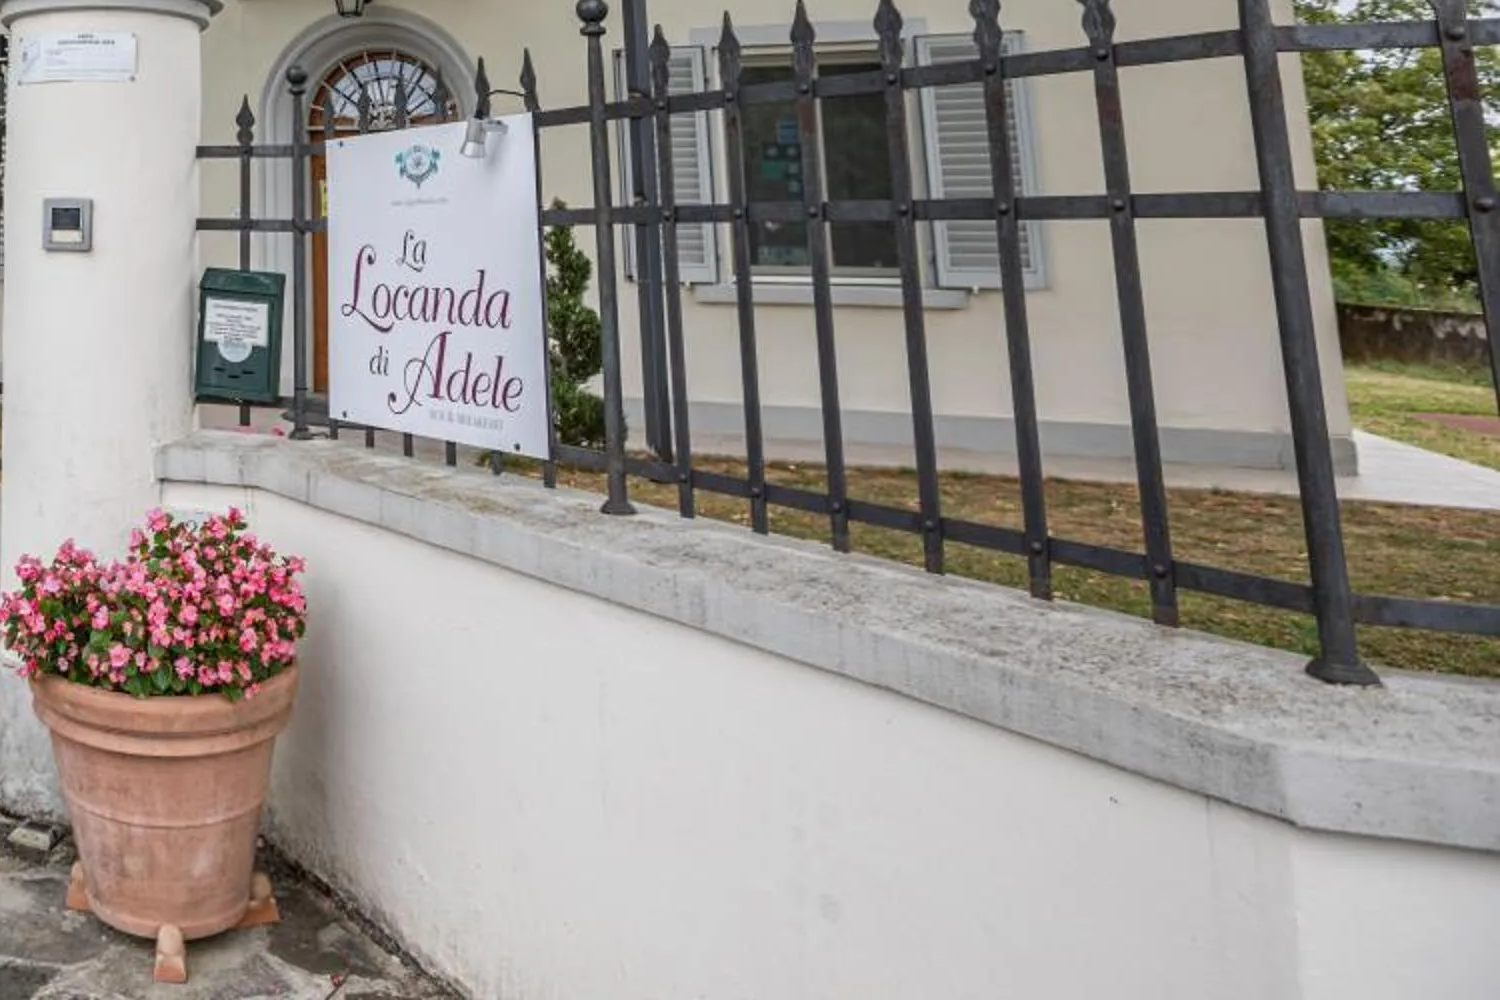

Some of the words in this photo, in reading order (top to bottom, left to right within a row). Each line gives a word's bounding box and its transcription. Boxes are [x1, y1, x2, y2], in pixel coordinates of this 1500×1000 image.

[341, 244, 511, 333] Locanda
[396, 228, 427, 273] La
[369, 345, 389, 377] di
[388, 331, 523, 415] Adele
